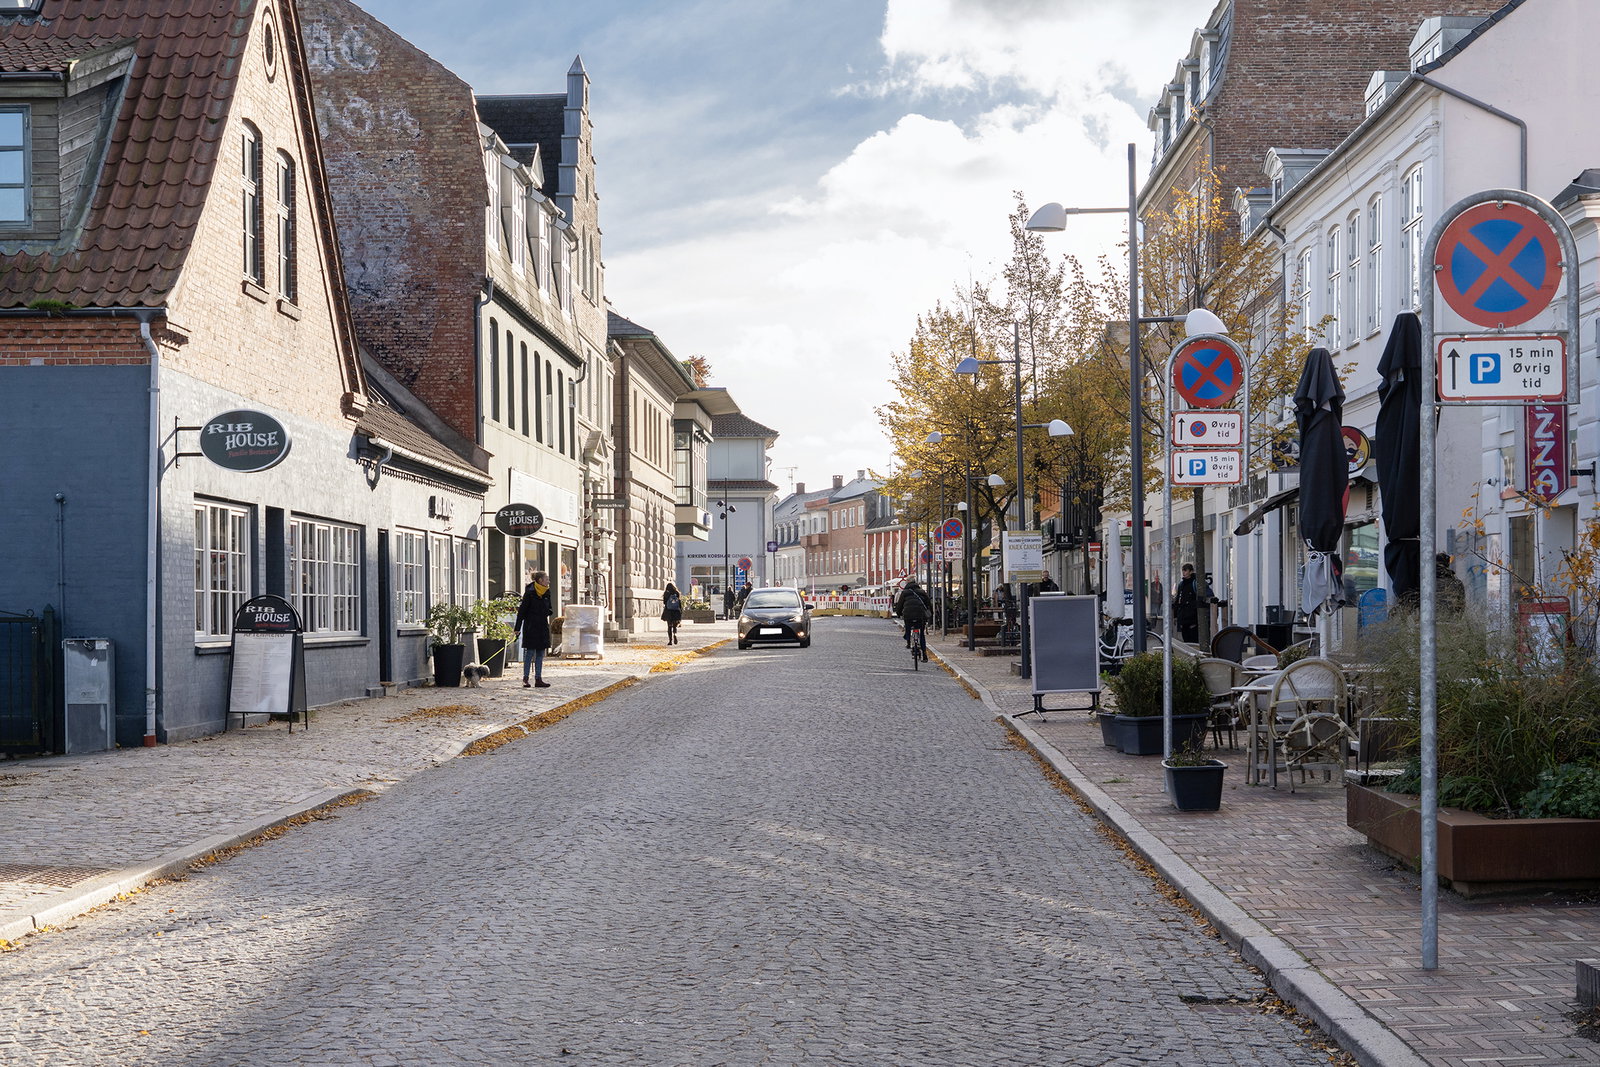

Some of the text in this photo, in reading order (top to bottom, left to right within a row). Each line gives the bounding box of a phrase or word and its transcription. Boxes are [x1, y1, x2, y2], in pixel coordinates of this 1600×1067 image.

[1509, 348, 1554, 358] 15 min
[1513, 363, 1551, 374] Øvrig
[1522, 378, 1542, 388] tid
[207, 423, 253, 434] RIB
[1211, 420, 1235, 429] Øvrig
[225, 431, 279, 450] HOUSE
[509, 515, 539, 526] HOUSE
[255, 613, 290, 622] HOUSE
